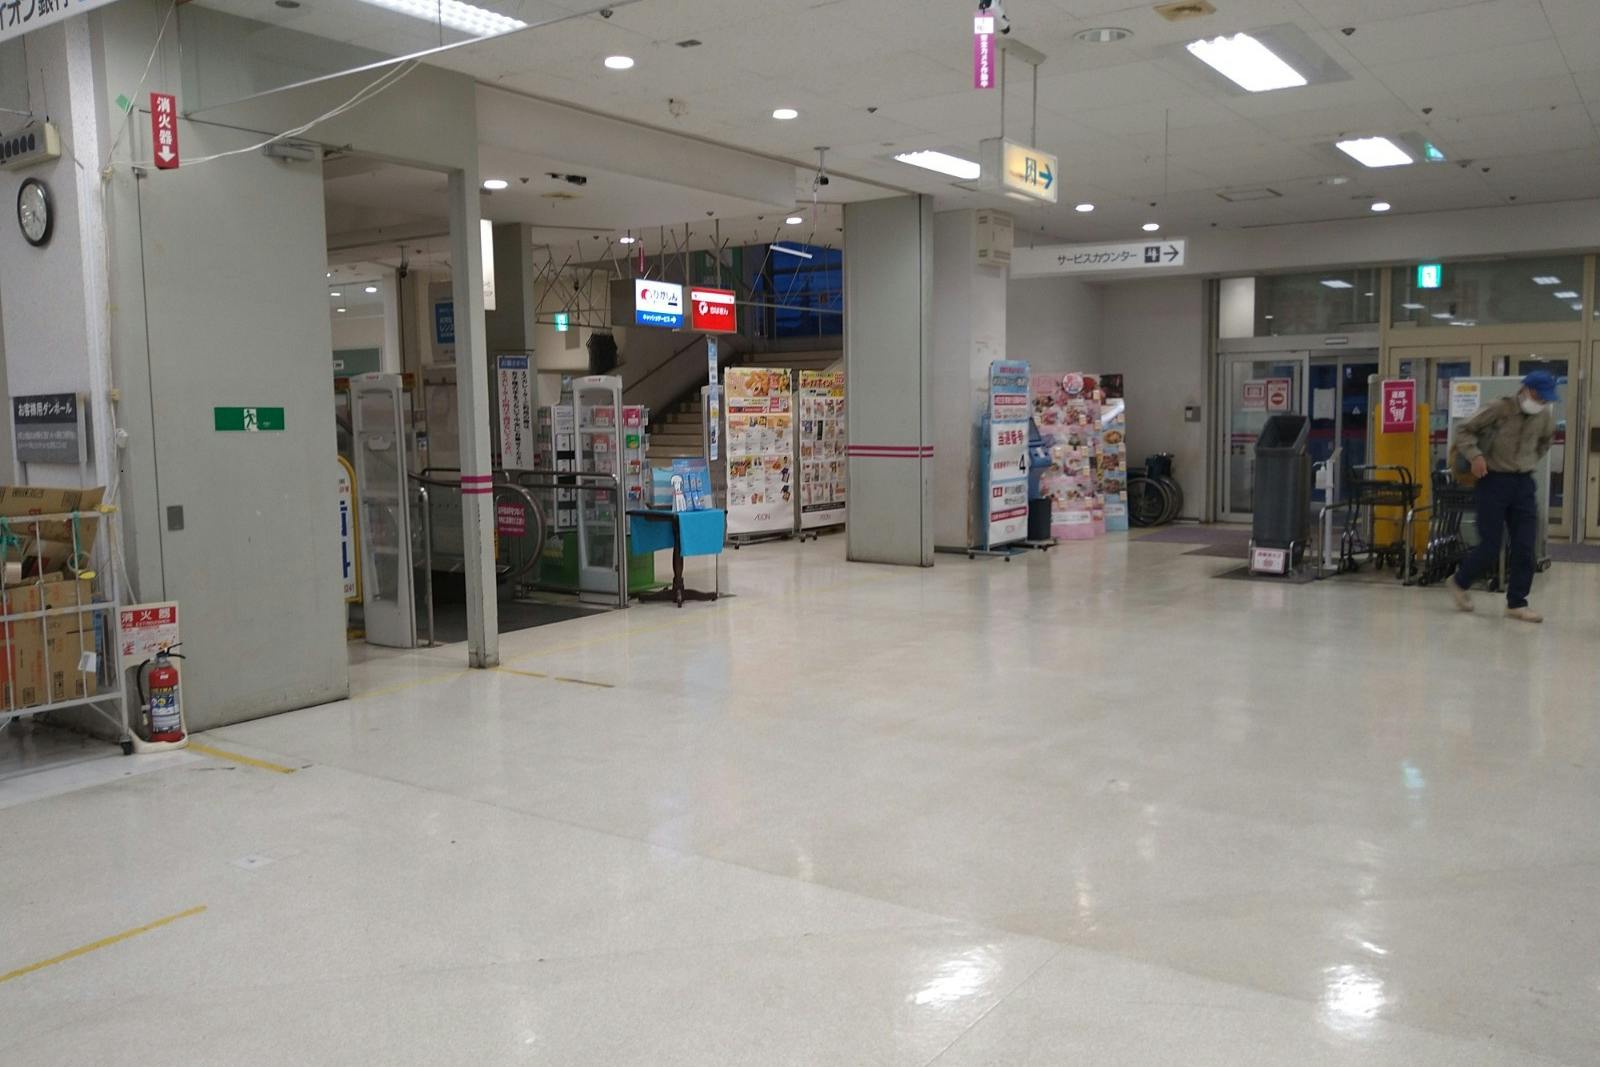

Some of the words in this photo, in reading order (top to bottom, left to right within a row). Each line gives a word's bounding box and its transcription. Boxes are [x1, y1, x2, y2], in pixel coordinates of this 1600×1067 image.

[157, 96, 172, 145] 消火器
[1057, 250, 1137, 266] サービスカウンター
[18, 401, 72, 416] お客様用ダンボール
[1019, 454, 1025, 475] 4
